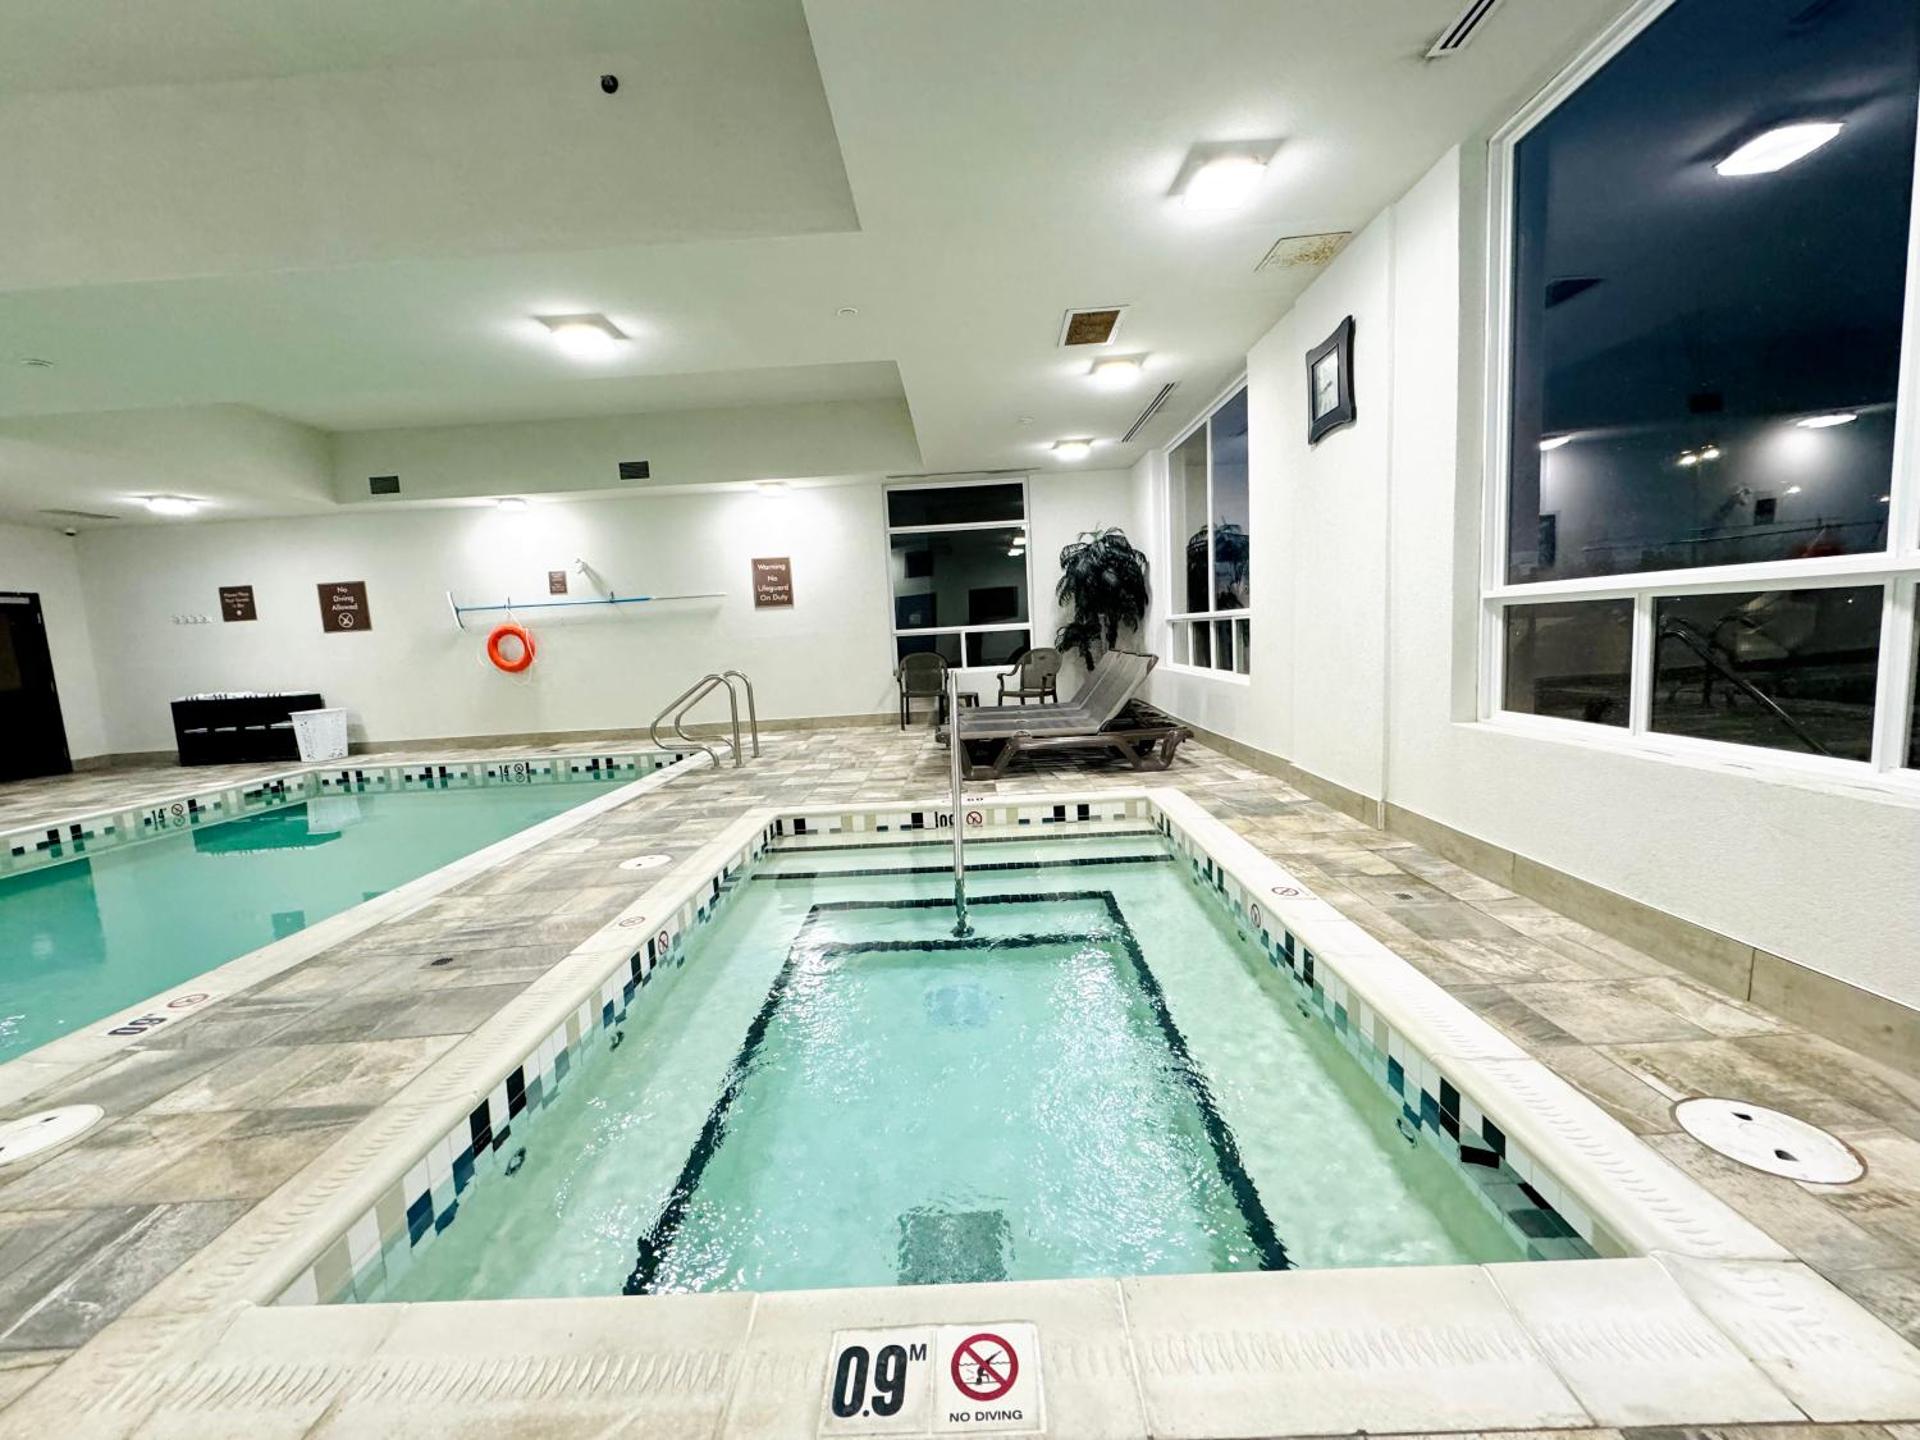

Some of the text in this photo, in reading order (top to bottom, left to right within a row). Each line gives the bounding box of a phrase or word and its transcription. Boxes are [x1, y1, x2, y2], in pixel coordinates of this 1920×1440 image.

[757, 584, 789, 593] Lifeguard
[333, 595, 354, 603] Diving
[773, 593, 788, 601] Duty
[332, 602, 358, 610] Allowed
[949, 1410, 1023, 1423] NO DIVING
